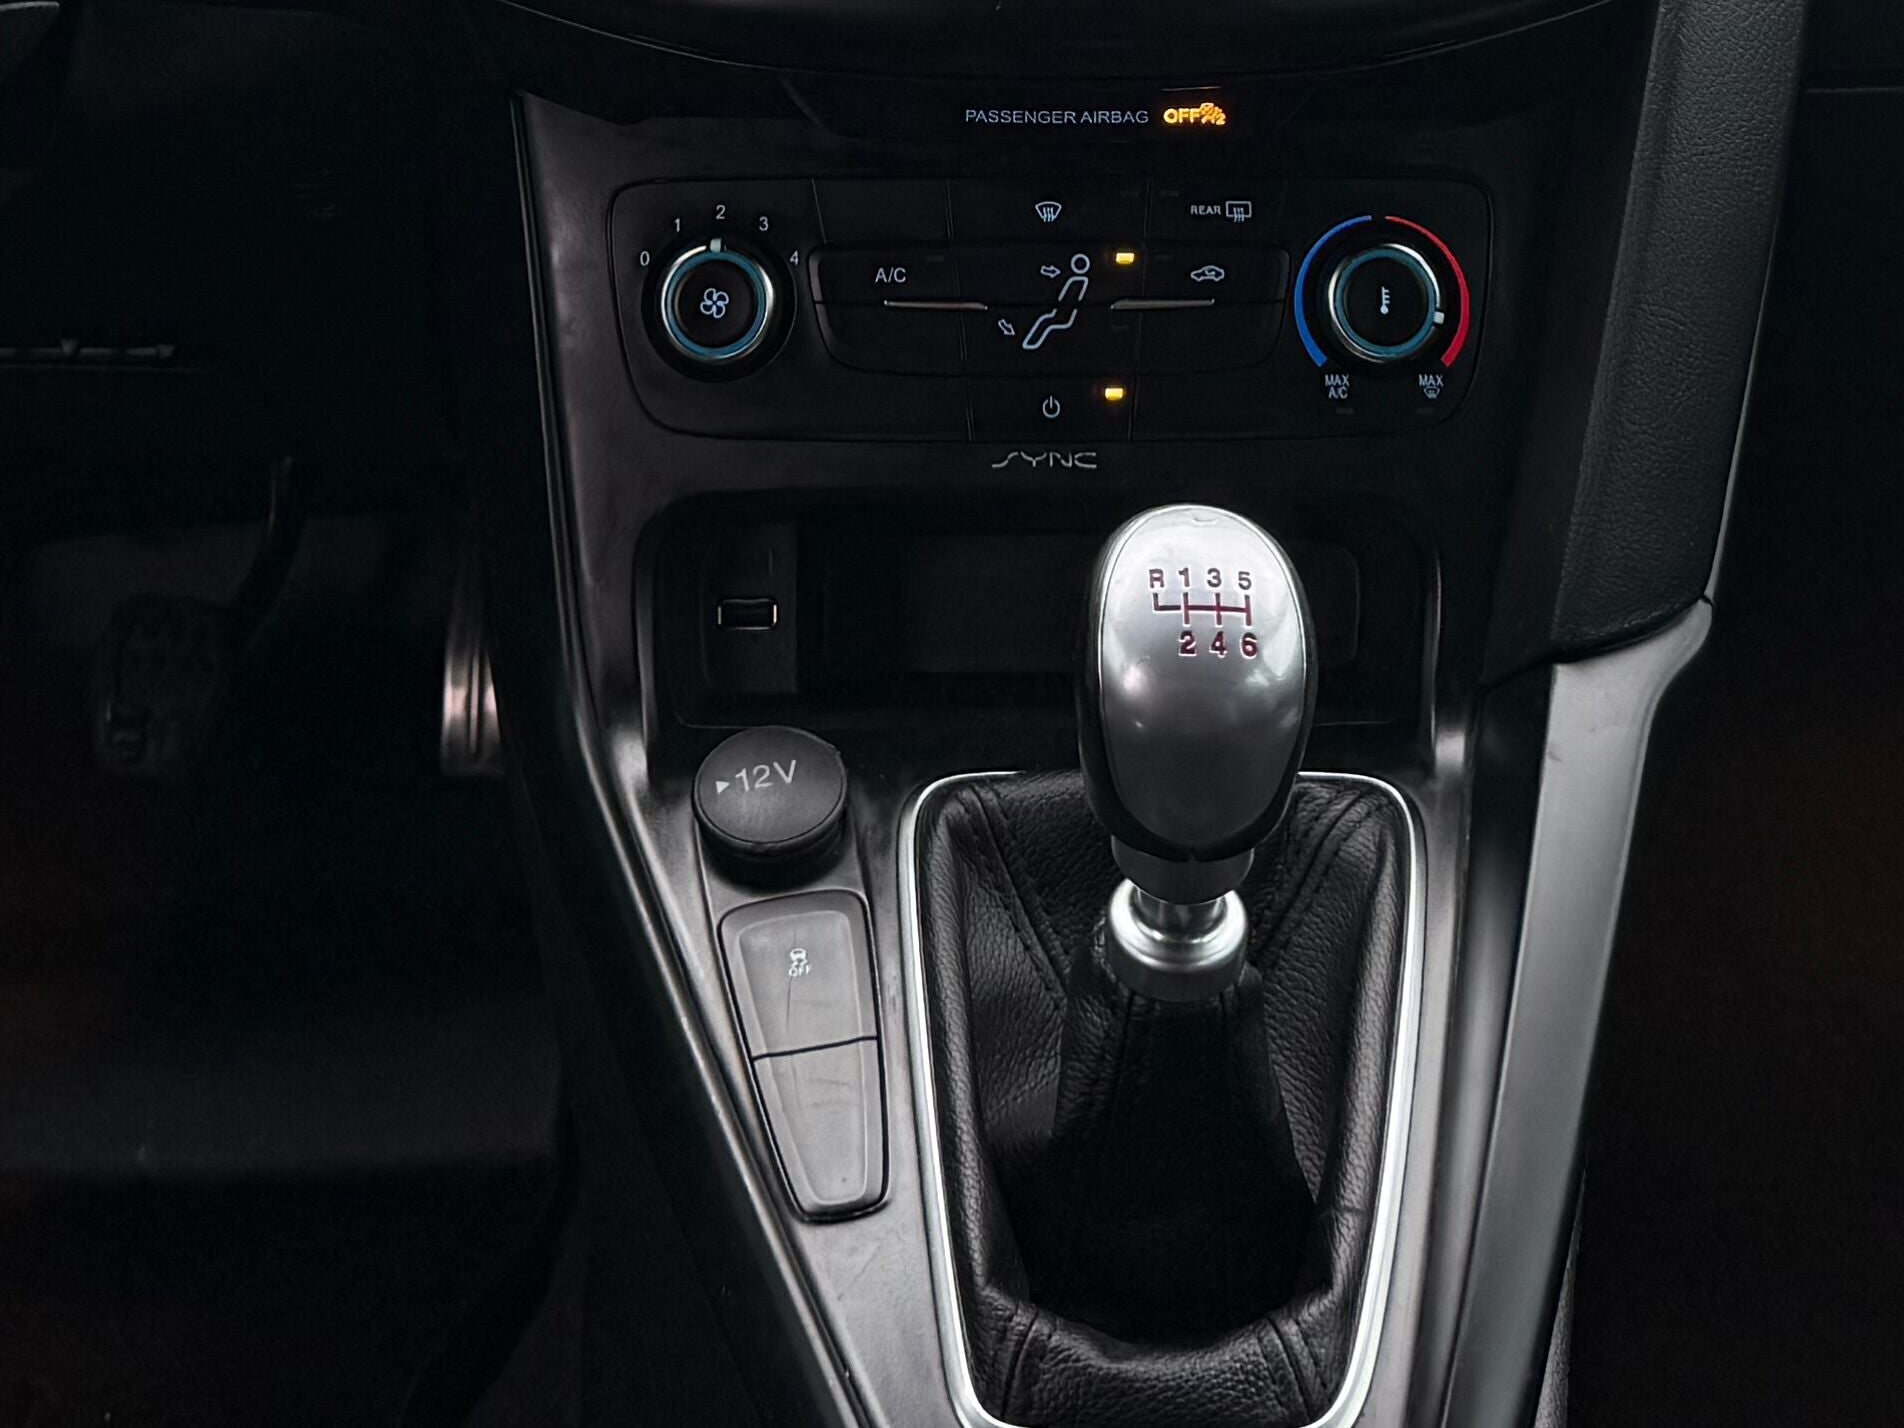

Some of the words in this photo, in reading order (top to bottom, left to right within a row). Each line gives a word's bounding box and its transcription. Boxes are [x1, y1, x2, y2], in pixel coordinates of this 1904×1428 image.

[964, 109, 1077, 125] PASSENGER
[1079, 109, 1150, 124] AIRBAG
[1162, 107, 1201, 124] OFF
[715, 204, 726, 220] 2
[1190, 204, 1221, 216] REAR
[673, 218, 682, 233] 1
[758, 216, 769, 232] 3
[639, 251, 650, 267] 0
[789, 251, 800, 267] 4
[874, 267, 907, 284] A/C
[1324, 374, 1350, 387] MAX
[1418, 374, 1444, 387] MAX
[1327, 386, 1349, 400] A/C
[992, 450, 1098, 469] SYNC
[1149, 568, 1165, 589] R
[1178, 567, 1190, 588] 1
[1206, 567, 1222, 588] 3
[1238, 570, 1253, 591] 5
[1178, 630, 1197, 657] 2
[1209, 630, 1227, 658] 4
[1240, 631, 1258, 658] 6
[734, 759, 798, 794] 12V
